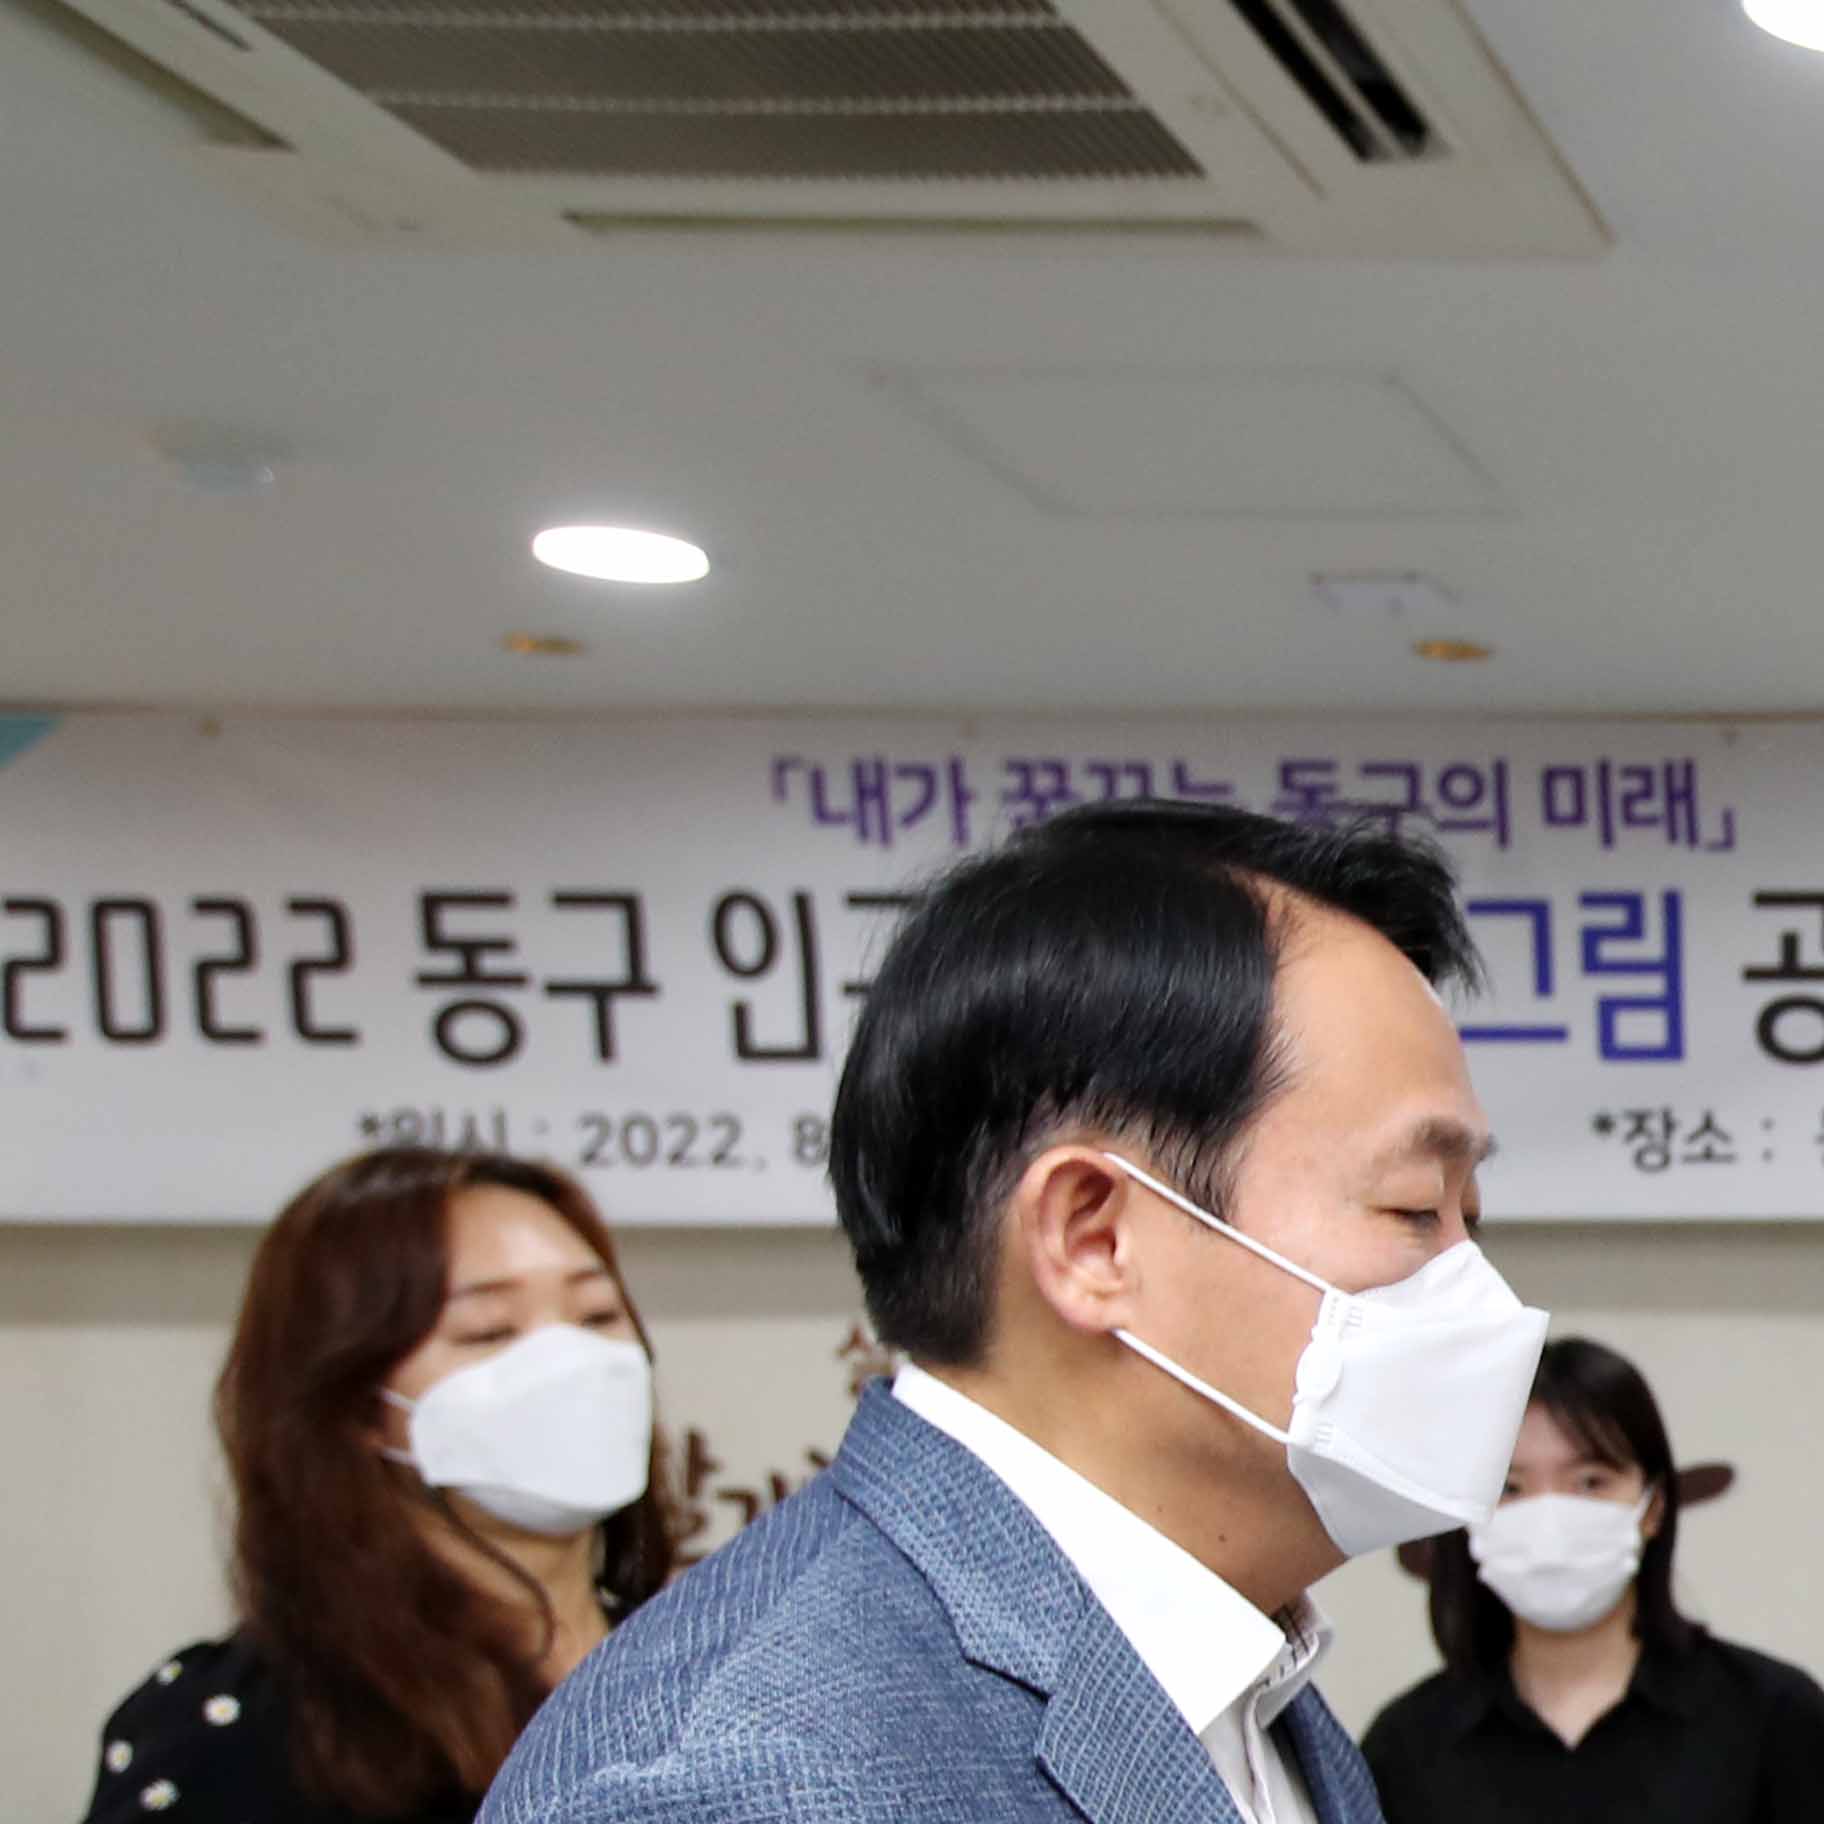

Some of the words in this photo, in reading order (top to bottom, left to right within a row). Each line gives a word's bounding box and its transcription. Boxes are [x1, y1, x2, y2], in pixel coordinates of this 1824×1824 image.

[771, 755, 974, 848] 「내가
[1541, 758, 1736, 850] 미래」
[2, 899, 358, 1044] 2022
[416, 892, 660, 1066] 동구
[1460, 888, 1684, 1062] 그림
[576, 1112, 766, 1170] 2022.
